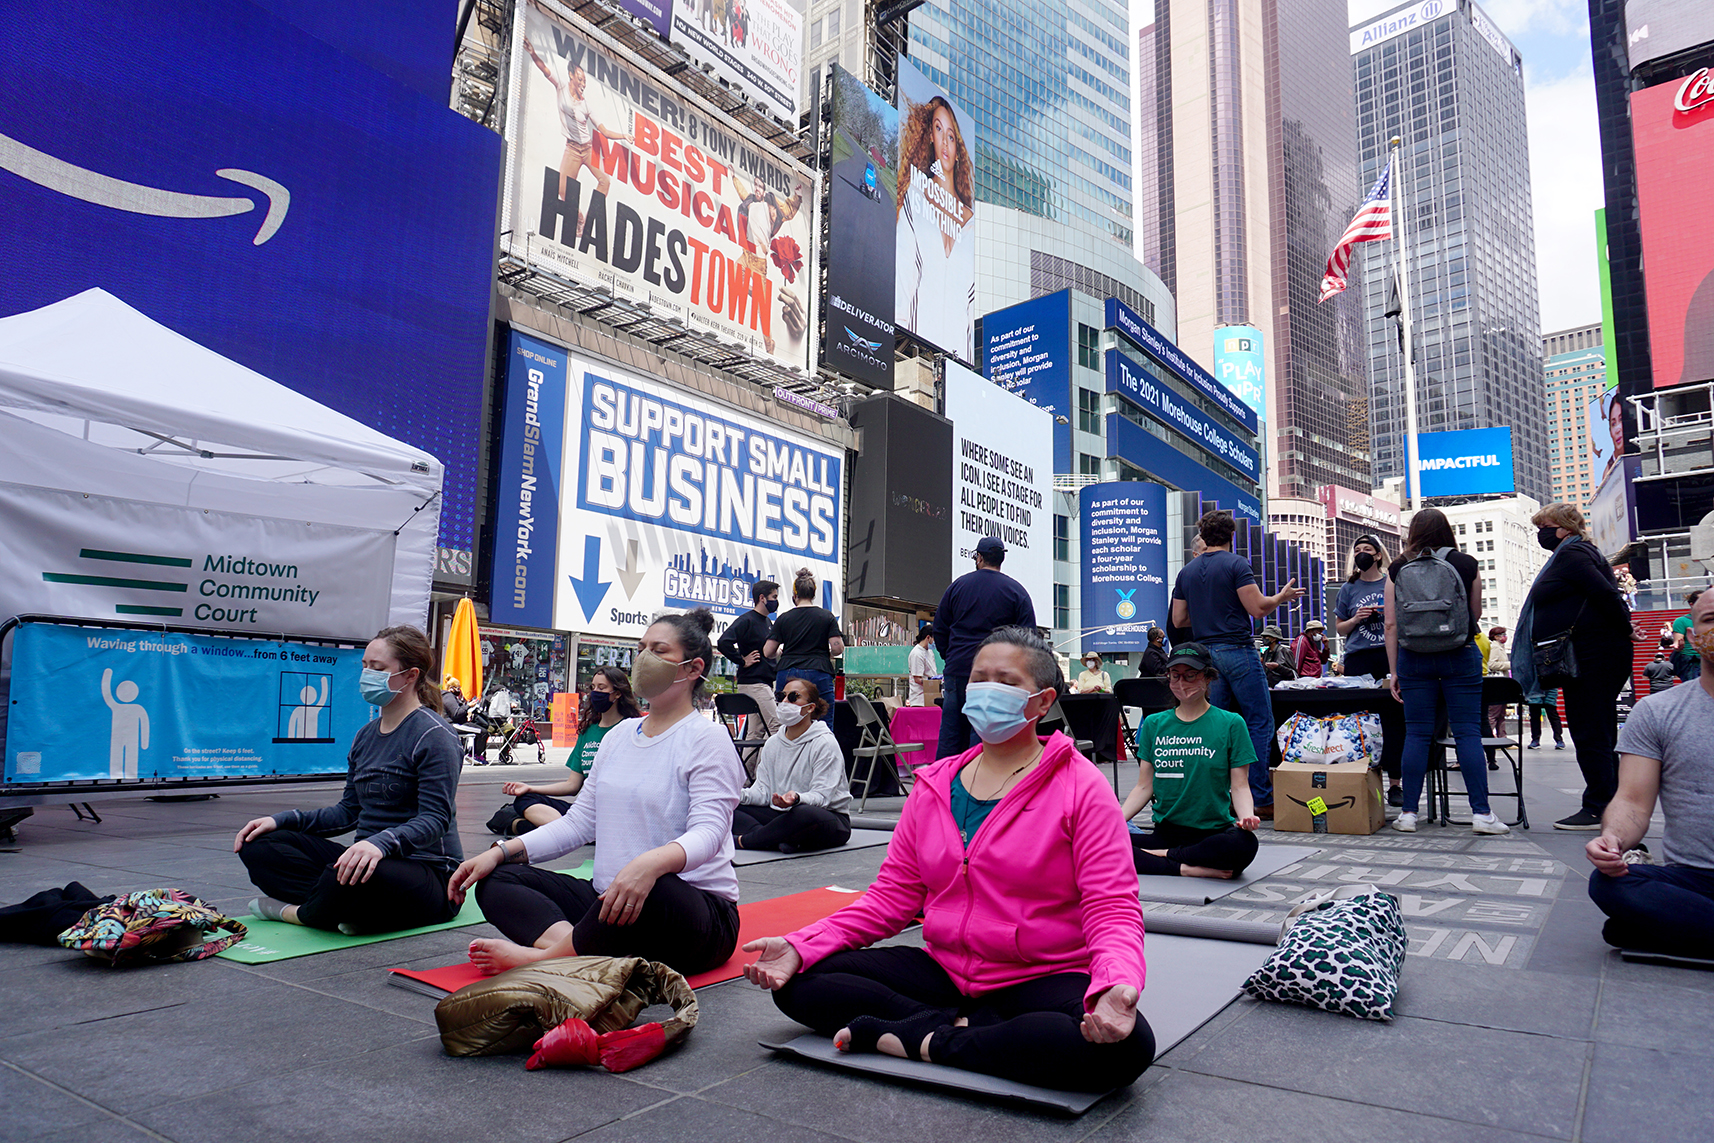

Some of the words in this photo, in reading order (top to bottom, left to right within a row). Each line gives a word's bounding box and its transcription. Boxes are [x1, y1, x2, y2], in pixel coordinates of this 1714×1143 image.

[783, 8, 794, 20] HIT
[755, 10, 771, 31] THE
[772, 22, 795, 50] PLAY
[1361, 12, 1417, 46] Allianz
[752, 19, 772, 41] THAT
[772, 36, 798, 67] GOES
[688, 28, 702, 43] NEW
[701, 36, 725, 59] WORLD
[723, 53, 744, 73] STAGES
[774, 91, 793, 108] STREET
[751, 32, 798, 84] WRONG
[551, 25, 684, 132] WINNER!
[688, 113, 698, 139] 8
[700, 125, 739, 163] TONY
[739, 145, 791, 197] AWARDS
[634, 111, 728, 196] BEST
[591, 129, 757, 254] MUSICAL
[910, 163, 965, 223] IMPOSSIBLE
[911, 191, 922, 214] IS
[921, 198, 963, 244] NOTHING
[539, 166, 773, 337] HADESTOWN
[557, 254, 579, 270] MITCHELL
[710, 319, 720, 330] KERR
[840, 300, 895, 336] DELIVERATOR
[990, 336, 1000, 344] As
[1000, 330, 1014, 342] part
[1014, 327, 1022, 336] of
[1022, 325, 1035, 334] our
[990, 336, 1031, 353] commitment
[1228, 338, 1258, 351] npr
[516, 346, 536, 364] SHOP
[535, 350, 557, 369] ONLINE
[836, 341, 888, 372] ARCIMOTO
[990, 349, 1018, 363] diversity
[1018, 345, 1032, 356] and
[1022, 352, 1049, 365] Morgan
[1118, 308, 1141, 336] Morgan
[1141, 327, 1166, 356] Stanley's
[1166, 347, 1186, 372] Institute
[1186, 362, 1194, 377] for
[1193, 369, 1213, 392] Inclusion
[1213, 384, 1229, 407] Proudly
[1228, 397, 1246, 420] Supports
[1015, 367, 1027, 377] will
[1027, 361, 1053, 375] provide
[777, 388, 815, 410] OUTFRONT
[817, 403, 836, 419] PRIME
[1120, 362, 1138, 393] The
[1139, 378, 1160, 408] 2021
[1161, 392, 1203, 436] Morehouse
[1203, 423, 1228, 454] College
[1228, 440, 1254, 471] Scholars
[591, 381, 746, 468] SUPPORT
[749, 434, 836, 498] SMALL
[960, 438, 988, 469] WHERE
[989, 451, 1011, 475] SOME
[1010, 460, 1023, 480] SEE
[1023, 464, 1034, 485] AN
[1418, 454, 1501, 471] IMPACTFUL
[512, 367, 544, 609] GrandSlamNewYork.com
[585, 427, 836, 555] BUSINESS
[960, 461, 982, 487] ICON,
[986, 472, 1000, 493] SEE
[999, 478, 1007, 497] A
[1006, 480, 1029, 506] STAGE
[1030, 489, 1042, 510] FOR
[960, 487, 976, 509] ALL
[976, 492, 1004, 518] PEOPLE
[1006, 501, 1016, 521] TO
[1016, 504, 1032, 527] FIND
[1091, 508, 1139, 517] commitment
[1102, 499, 1118, 508] part
[960, 511, 983, 536] THEIR
[984, 518, 1002, 539] OWN
[1003, 523, 1030, 549] VOICES.
[1091, 517, 1123, 527] diversity
[1091, 526, 1128, 536] inclusion,
[1130, 526, 1158, 535] Morgan
[1092, 536, 1119, 545] Stanley
[1137, 537, 1162, 545] provide
[1092, 546, 1108, 554] each
[202, 554, 299, 579] Midtown
[1092, 564, 1137, 573] scholarship
[1097, 555, 1133, 564] four-year
[664, 567, 731, 606] GRAND
[731, 577, 755, 609] SL
[1092, 574, 1135, 583] Morehouse
[1137, 574, 1163, 584] College.
[199, 579, 320, 606] Community
[193, 603, 258, 624] Court
[610, 607, 648, 626] Sports
[711, 605, 722, 613] NEW
[723, 607, 736, 615] YORK
[87, 636, 136, 653] Waving
[139, 639, 188, 655] through
[191, 646, 198, 654] a
[279, 652, 288, 661] 6
[291, 651, 310, 662] feet
[312, 654, 338, 666] away
[538, 670, 547, 678] 26
[584, 741, 600, 749] Midto
[1154, 746, 1216, 759] Community
[1155, 736, 1203, 746] Midtown
[1154, 759, 1184, 768] Court
